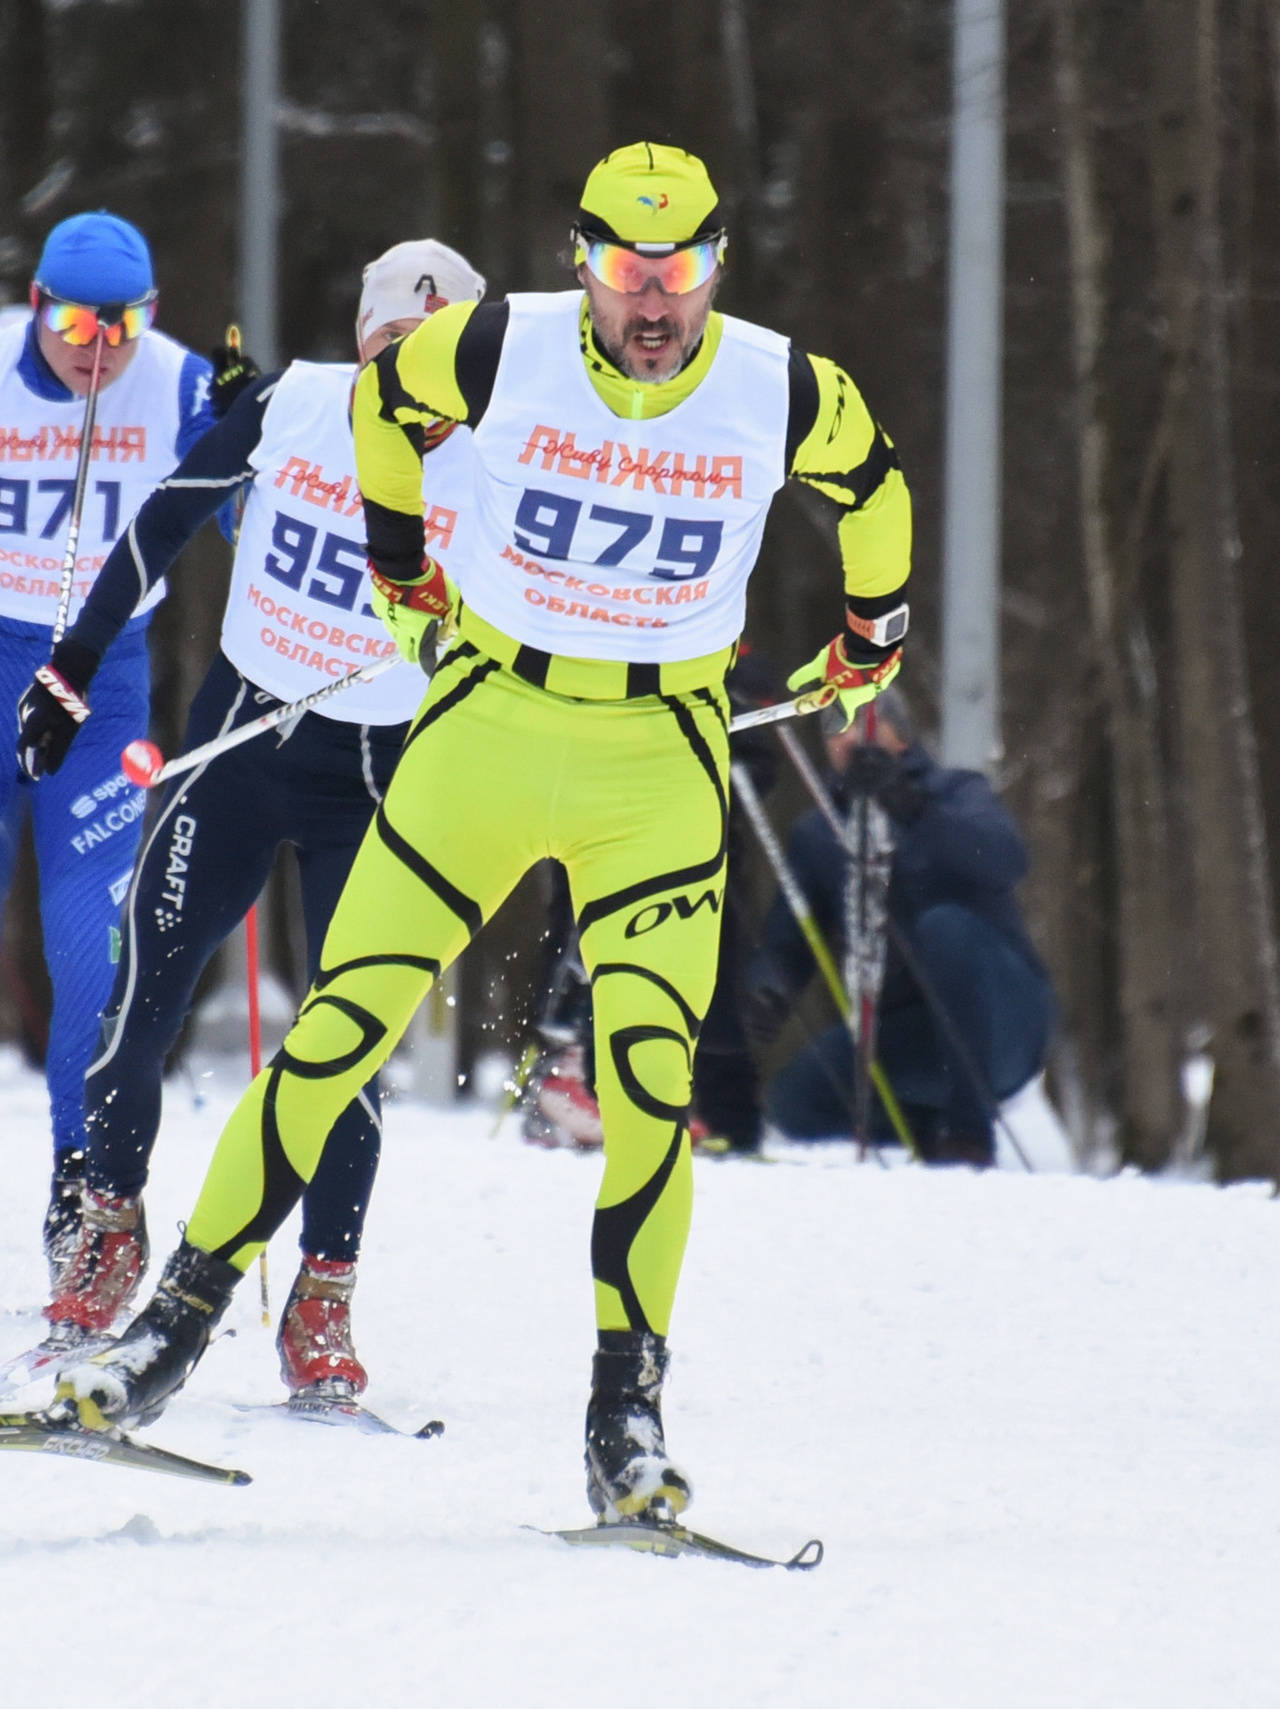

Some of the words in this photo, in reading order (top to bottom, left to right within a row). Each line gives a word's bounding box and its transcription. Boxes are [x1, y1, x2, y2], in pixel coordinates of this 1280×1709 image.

[518, 424, 743, 498] ЛЫЖНЯ
[264, 511, 382, 620] 95
[514, 488, 724, 580] 979
[501, 544, 709, 605] МОСКОВСКАЯ
[524, 588, 669, 628] ОБЛАСТЬ
[247, 584, 398, 657] МОСКОВСКА
[162, 815, 196, 910] CRAFT
